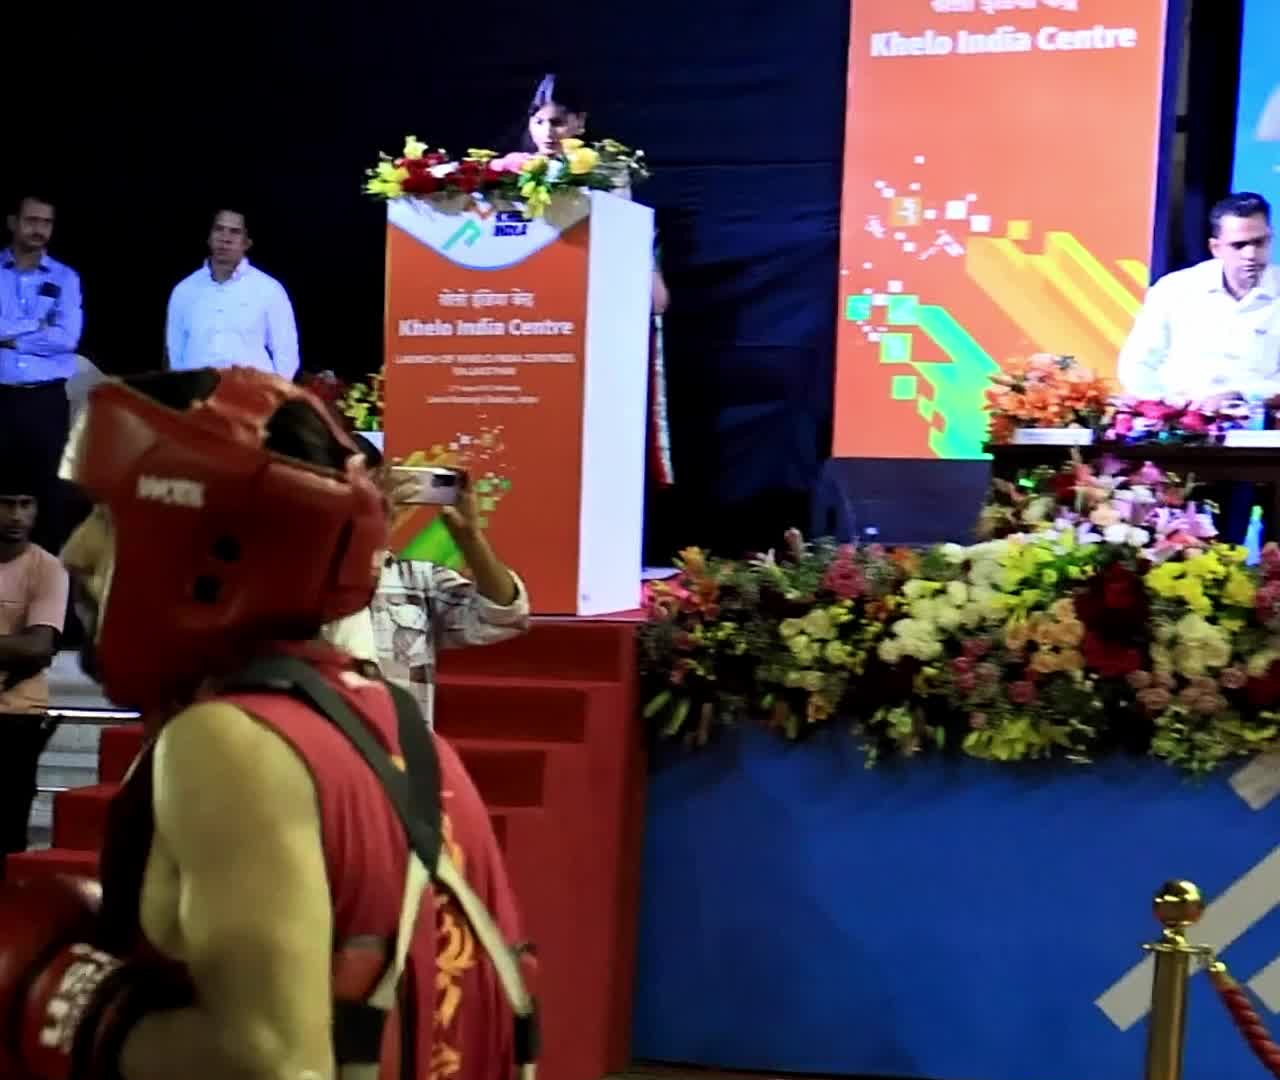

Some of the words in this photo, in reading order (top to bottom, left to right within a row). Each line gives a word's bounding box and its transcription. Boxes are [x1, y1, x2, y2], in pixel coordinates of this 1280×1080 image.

[870, 30, 953, 56] Khelo
[957, 25, 1032, 54] India
[1037, 25, 1138, 50] Centre
[398, 318, 453, 336] Khelo
[456, 317, 505, 336] India
[509, 318, 576, 336] Centre
